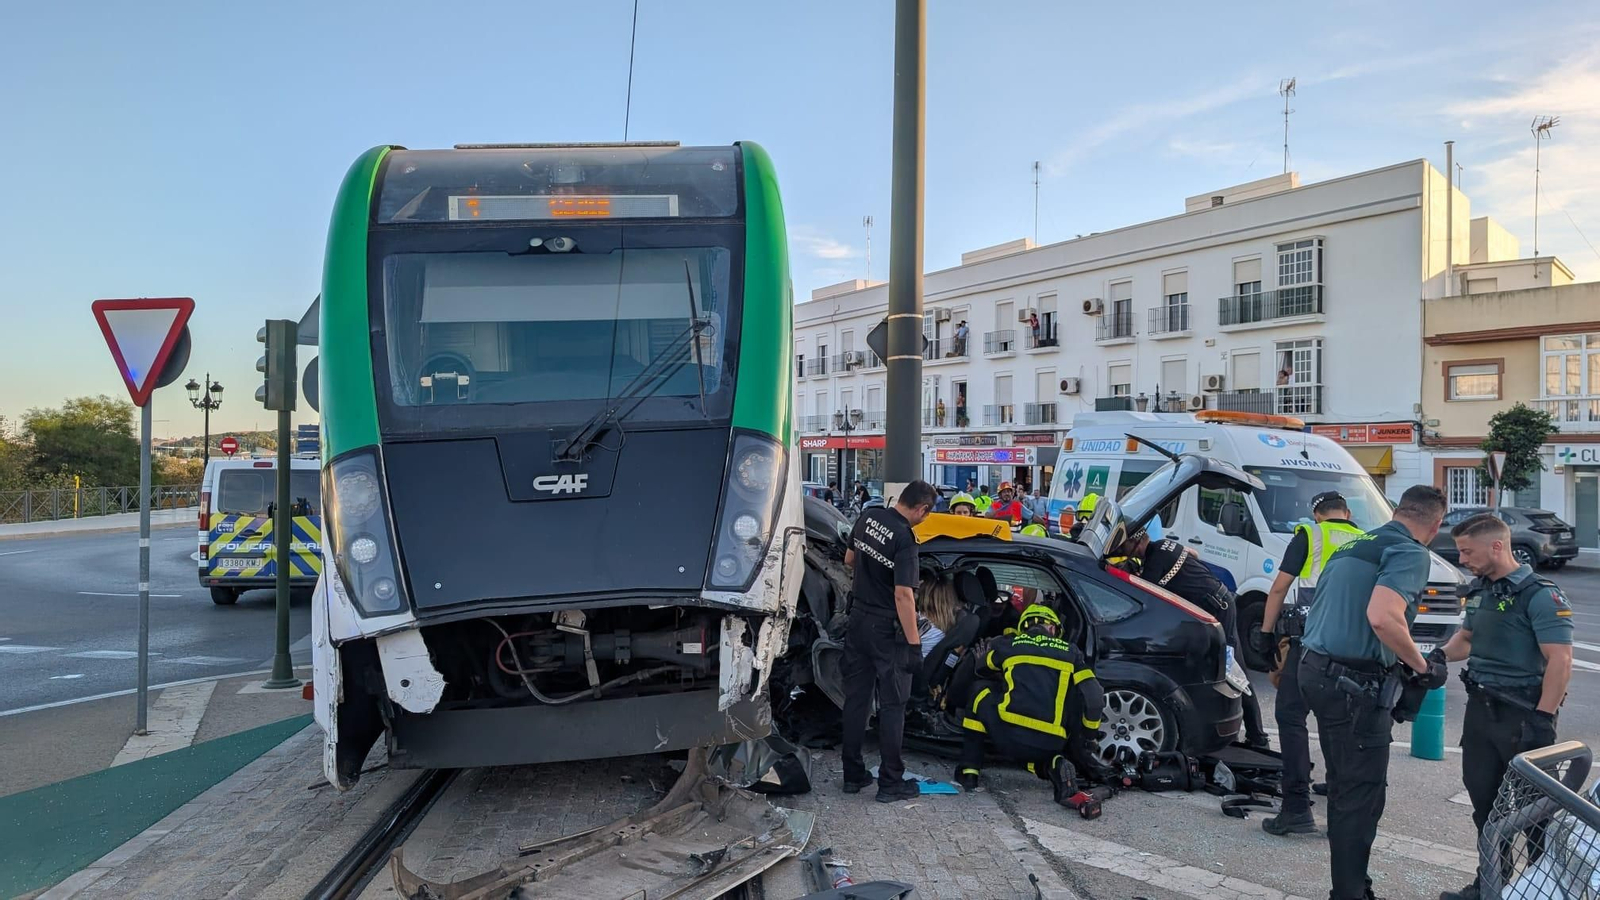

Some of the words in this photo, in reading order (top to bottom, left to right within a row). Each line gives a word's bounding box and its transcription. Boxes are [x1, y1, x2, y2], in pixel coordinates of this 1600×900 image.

[803, 439, 827, 448] SHARP
[960, 436, 997, 445] INTERACTIVA
[1081, 441, 1121, 452] UNIDAD
[533, 474, 588, 494] CAF
[866, 517, 894, 540] POLICIA
[865, 526, 886, 545] LOCAL
[216, 542, 272, 550] POLICIA
[225, 559, 243, 567] 3380
